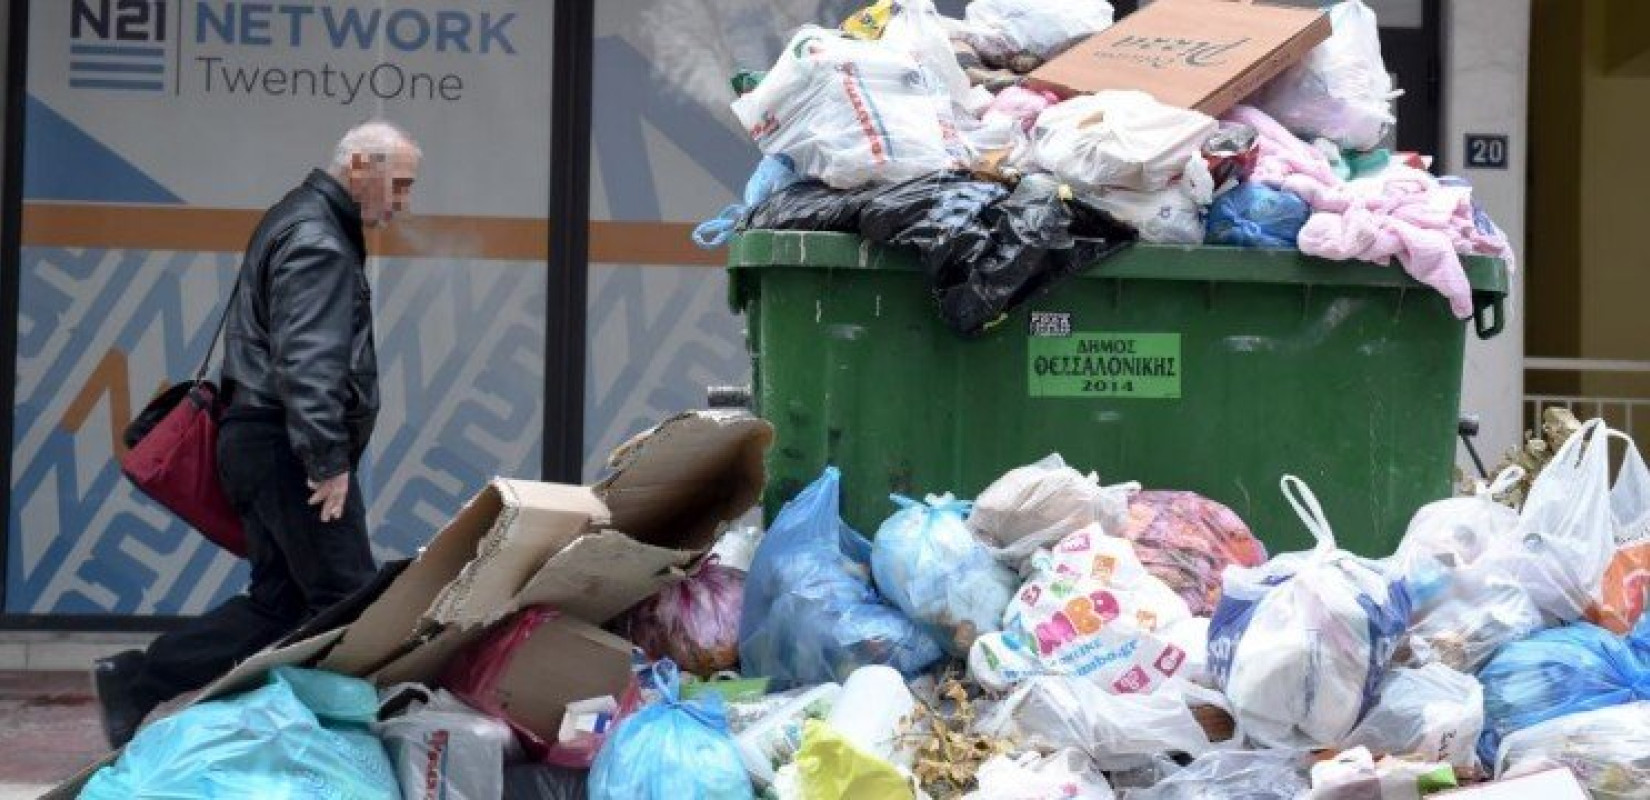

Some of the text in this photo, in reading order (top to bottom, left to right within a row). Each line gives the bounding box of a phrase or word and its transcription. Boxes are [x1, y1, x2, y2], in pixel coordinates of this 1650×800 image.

[70, 0, 166, 41] N21
[195, 1, 517, 54] NETWORK
[195, 57, 464, 104] TwentyOne
[1471, 139, 1503, 163] 20
[1076, 339, 1137, 354] ΔΗΜΟΣ
[1034, 355, 1177, 377] ΘΕΣΣΑΛΟΝΙΚΗΣ
[1081, 379, 1134, 392] 2014
